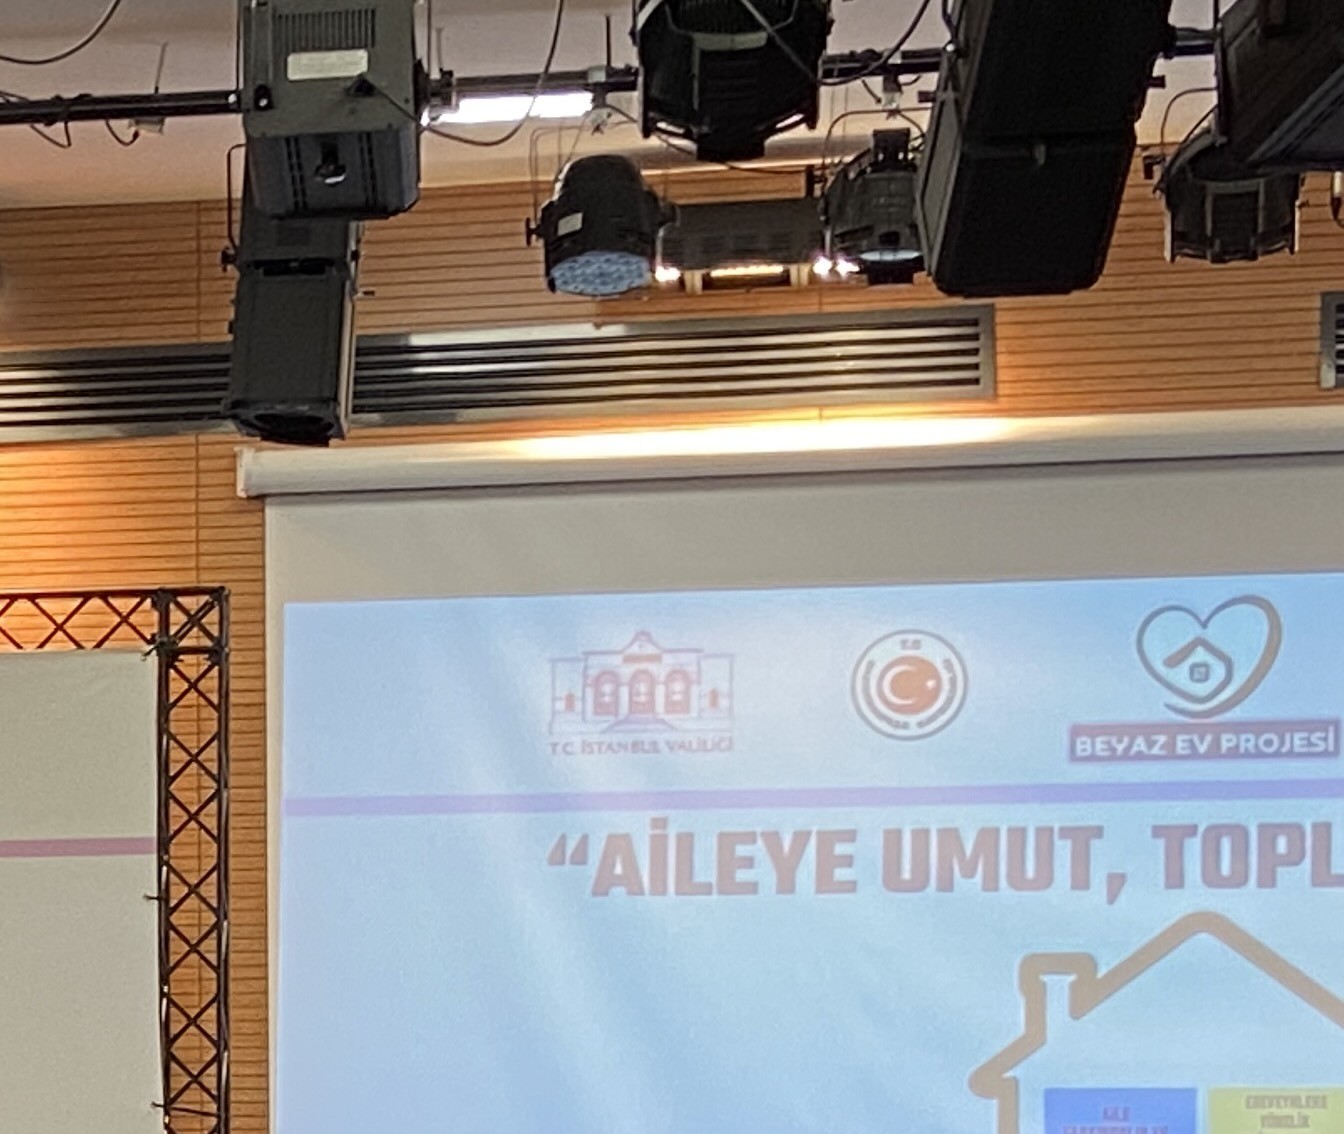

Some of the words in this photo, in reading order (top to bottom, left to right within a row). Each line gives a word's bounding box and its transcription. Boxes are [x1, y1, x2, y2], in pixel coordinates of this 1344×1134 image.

[581, 738, 662, 755] İSTANBUL
[1075, 735, 1168, 757] BEYAZ
[1175, 734, 1212, 755] EV
[1220, 725, 1335, 754] PROJESİ
[881, 825, 1127, 905] UMUT,
